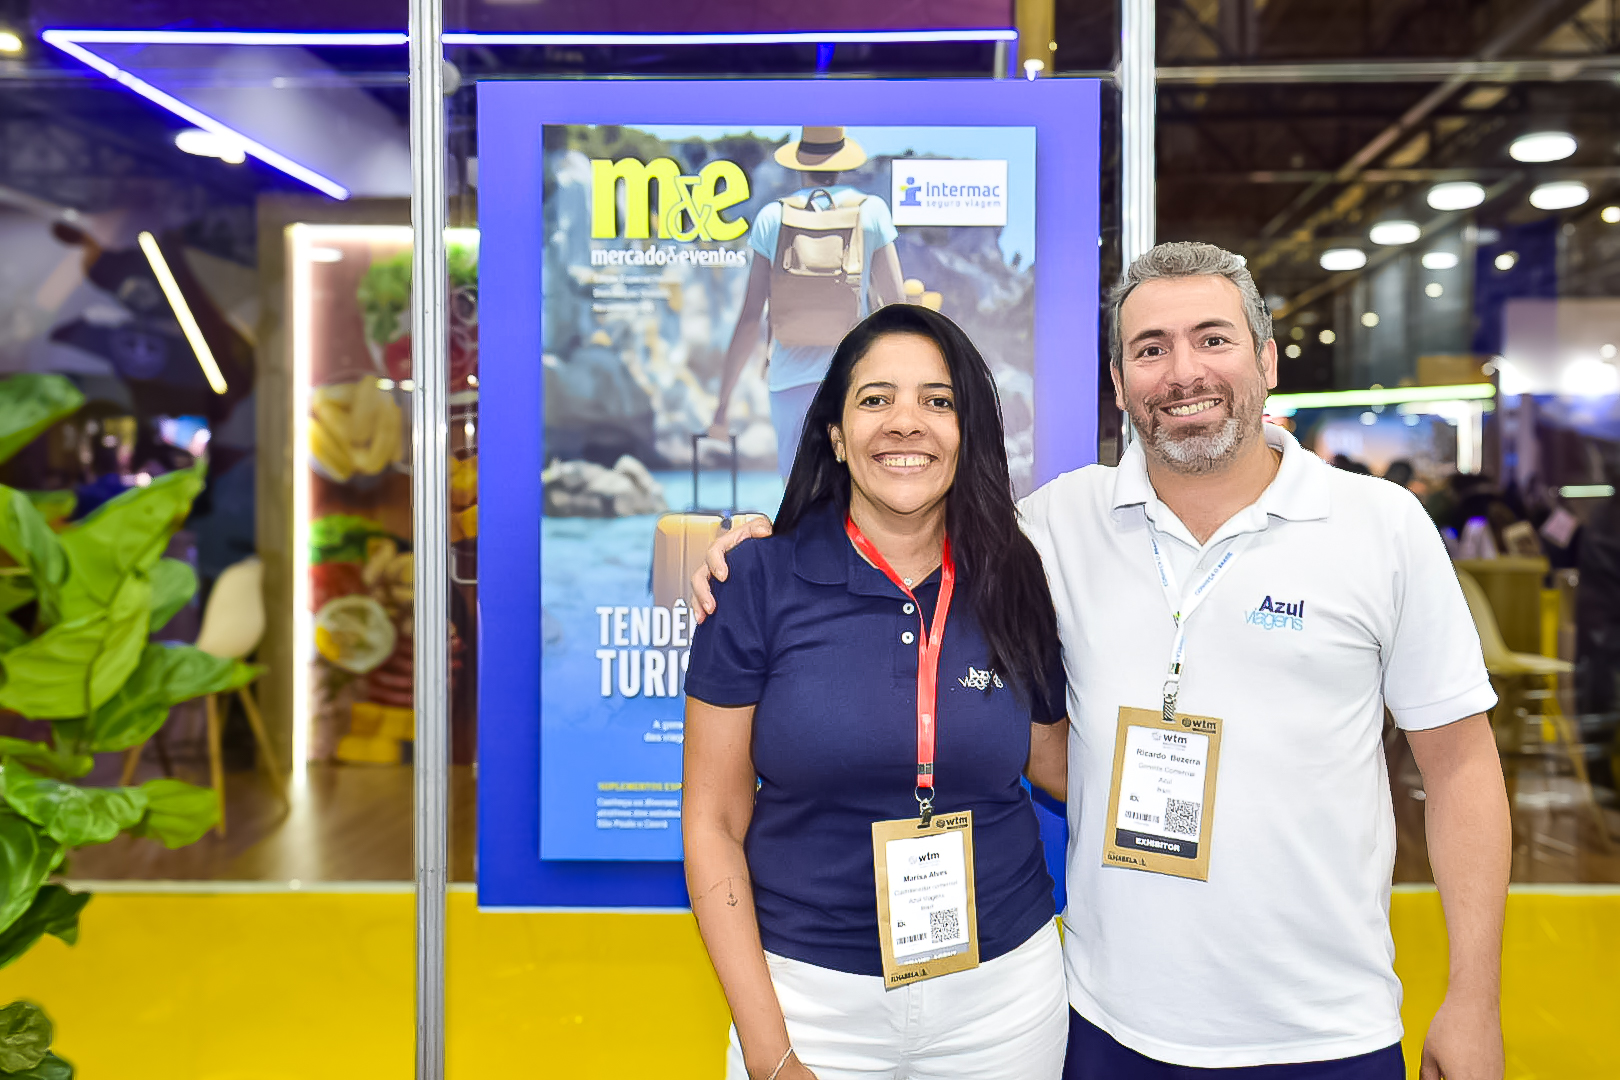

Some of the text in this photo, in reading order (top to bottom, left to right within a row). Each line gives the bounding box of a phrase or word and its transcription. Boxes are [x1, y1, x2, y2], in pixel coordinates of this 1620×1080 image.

[591, 157, 750, 242] m&e
[1259, 595, 1304, 618] Azul
[1245, 608, 1303, 631] viagens
[1192, 719, 1216, 729] wtm
[1163, 734, 1188, 744] wtm
[1136, 748, 1167, 760] Ricardo
[946, 816, 967, 826] wtm
[1135, 837, 1181, 852] EXHIBITOR
[918, 851, 940, 862] wtm
